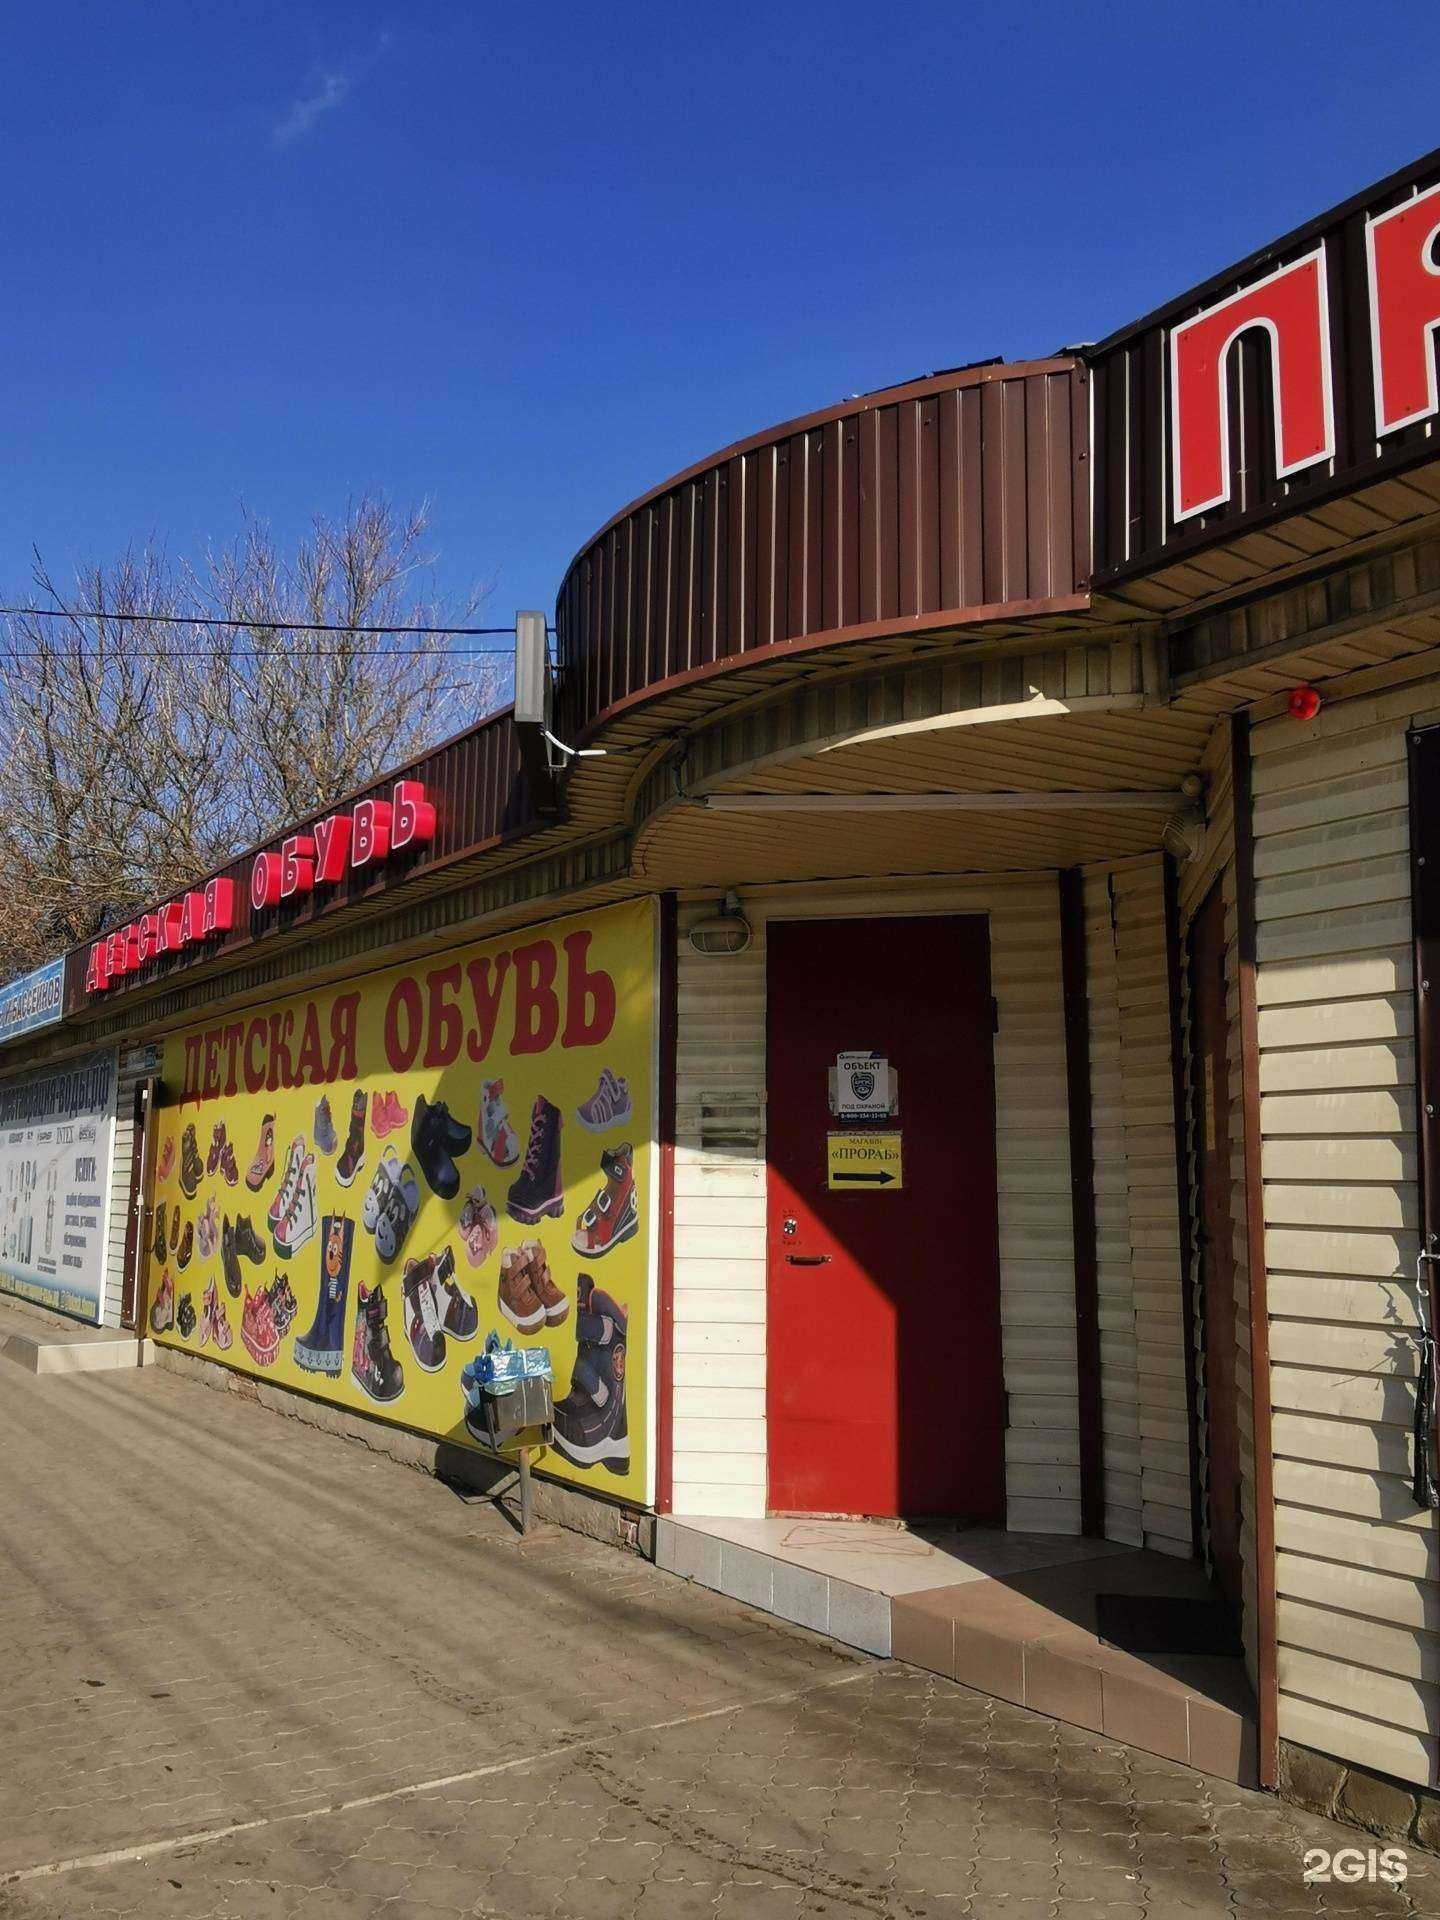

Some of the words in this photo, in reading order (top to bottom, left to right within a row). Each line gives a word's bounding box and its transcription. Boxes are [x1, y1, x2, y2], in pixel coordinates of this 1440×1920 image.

[86, 877, 233, 992] ДЕТСКАЯ
[252, 780, 436, 909] ОБУВЬ
[179, 990, 361, 1113] ДЕТСКАЯ
[384, 930, 617, 1073] ОБУВЬ
[843, 1061, 881, 1071] ОБЪЕКТ
[832, 1148, 900, 1160] «ПРОРАБ»
